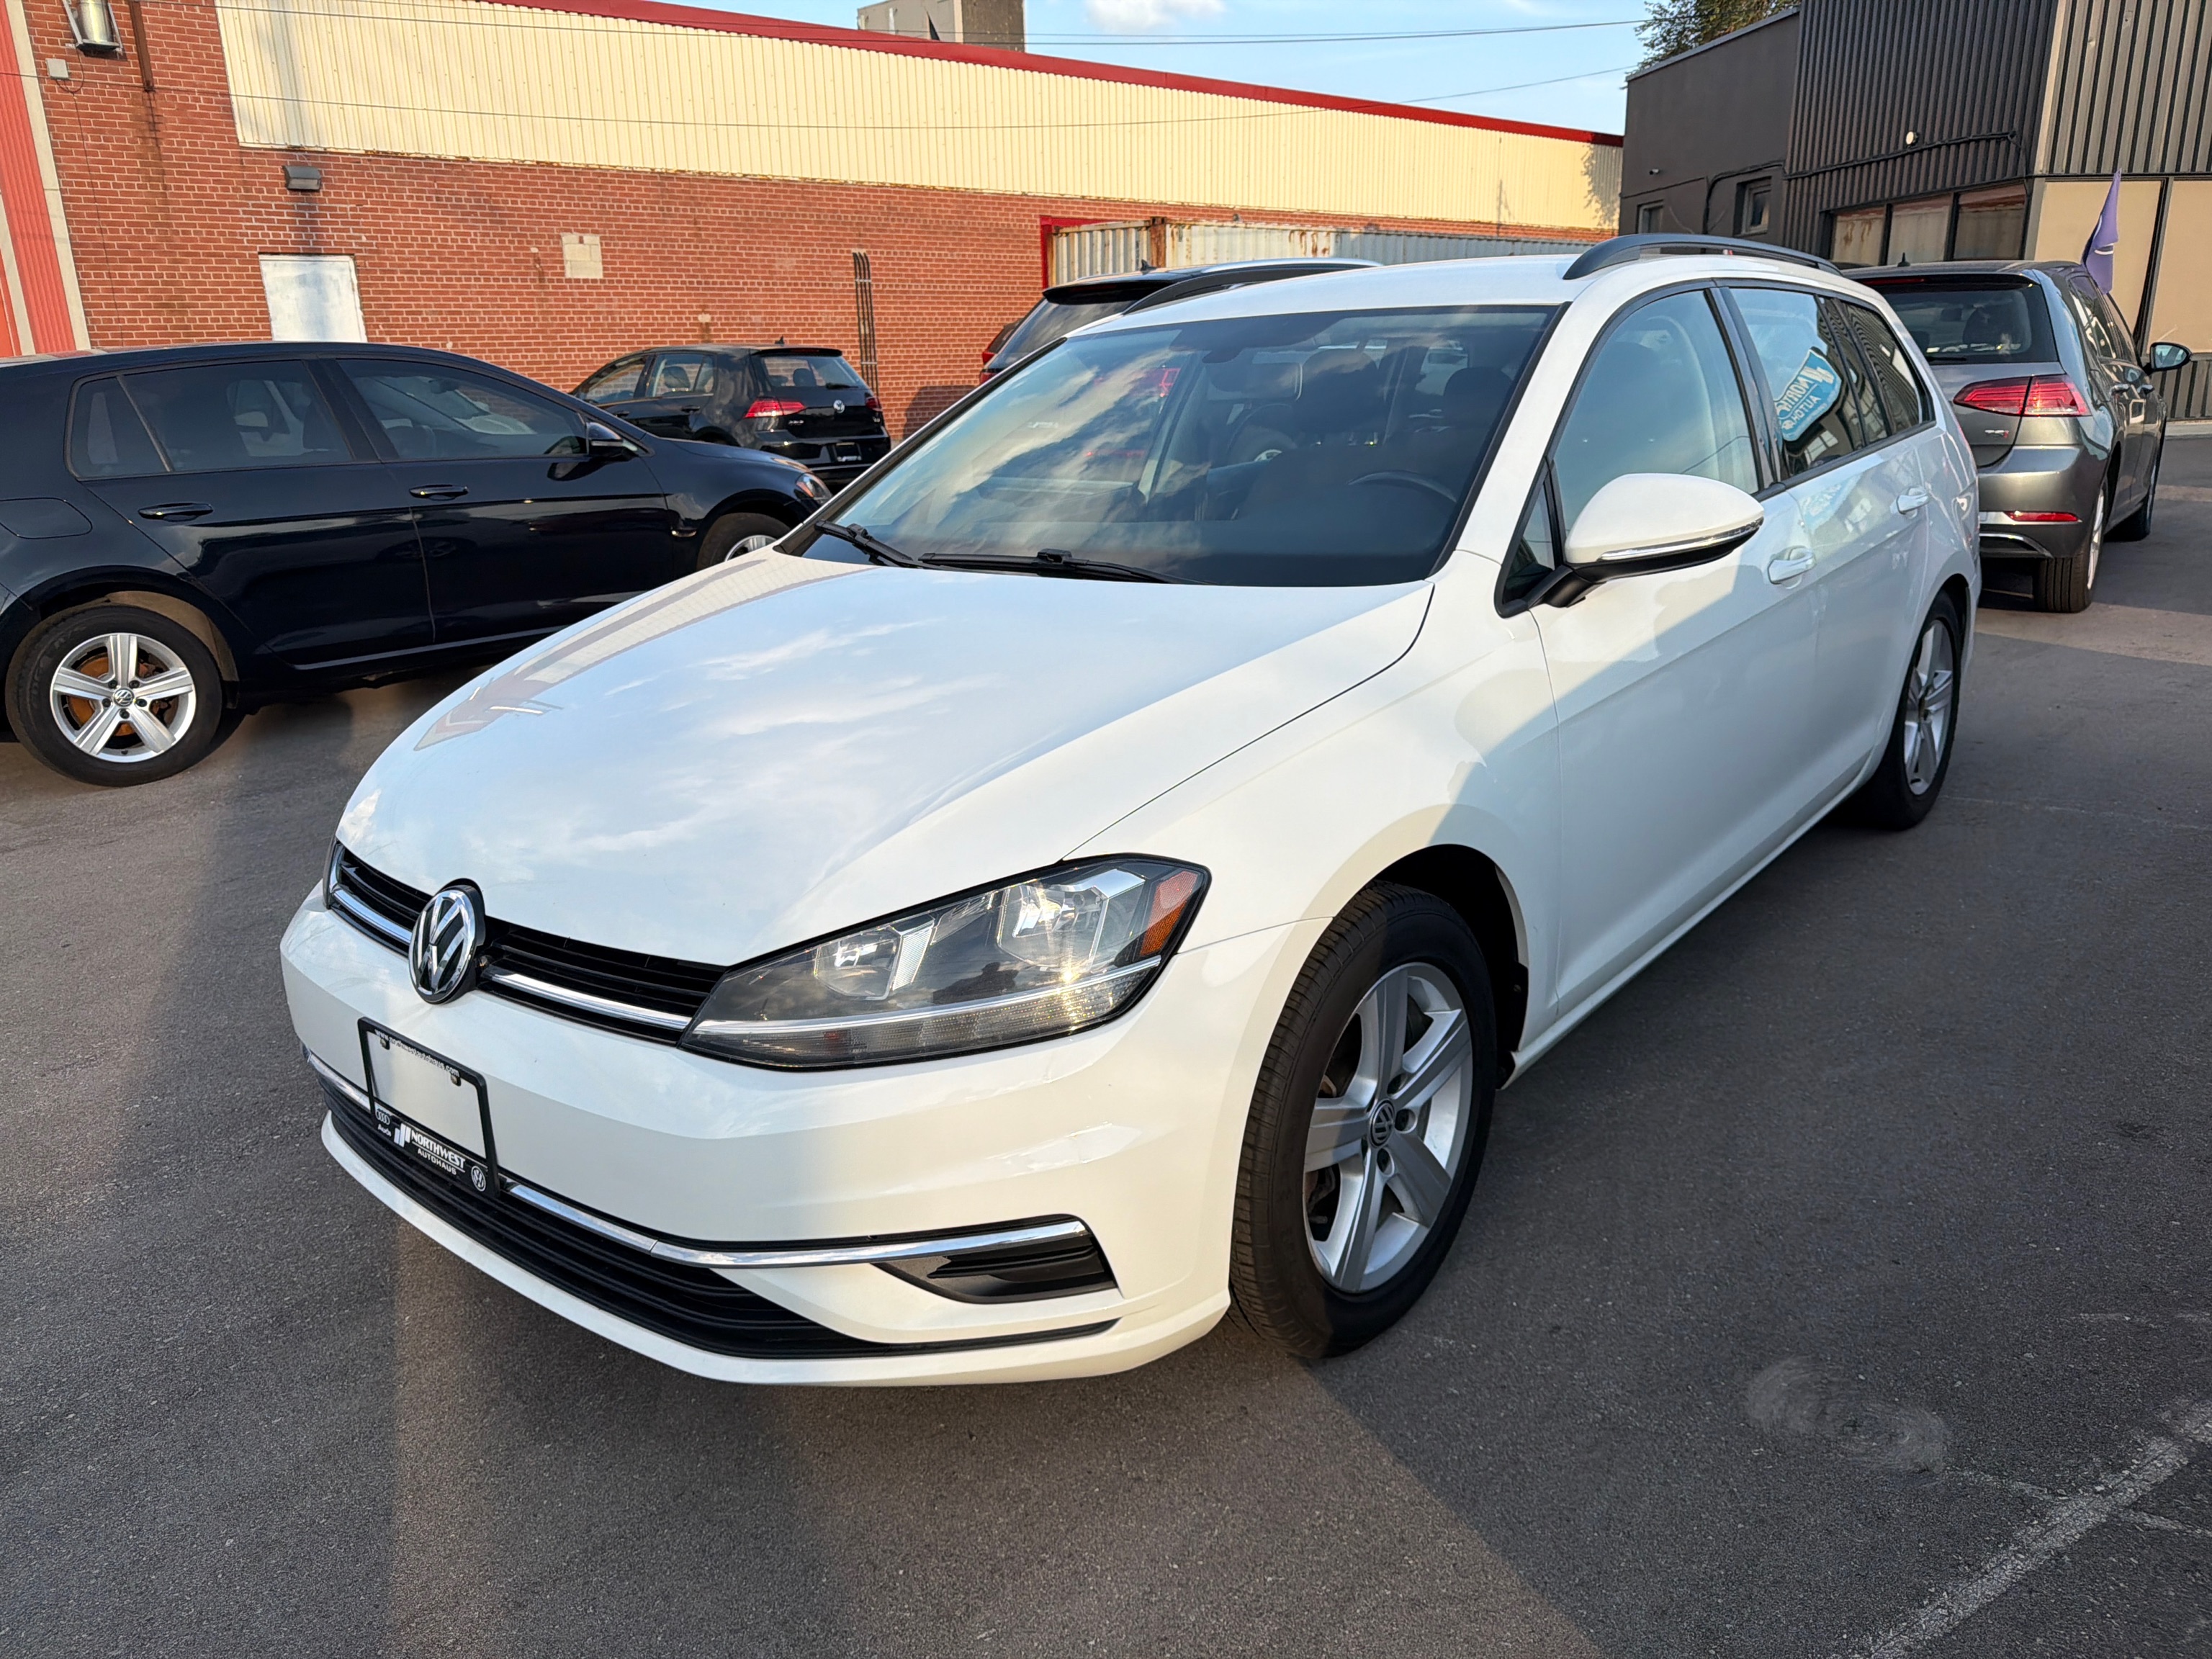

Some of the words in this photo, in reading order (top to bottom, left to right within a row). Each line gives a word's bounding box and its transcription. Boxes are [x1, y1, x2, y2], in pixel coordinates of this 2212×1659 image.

[409, 889, 475, 997] VW
[411, 1130, 466, 1169] NORTHWEST
[417, 1148, 457, 1176] AUTOHAUS
[471, 1165, 486, 1192] VW
